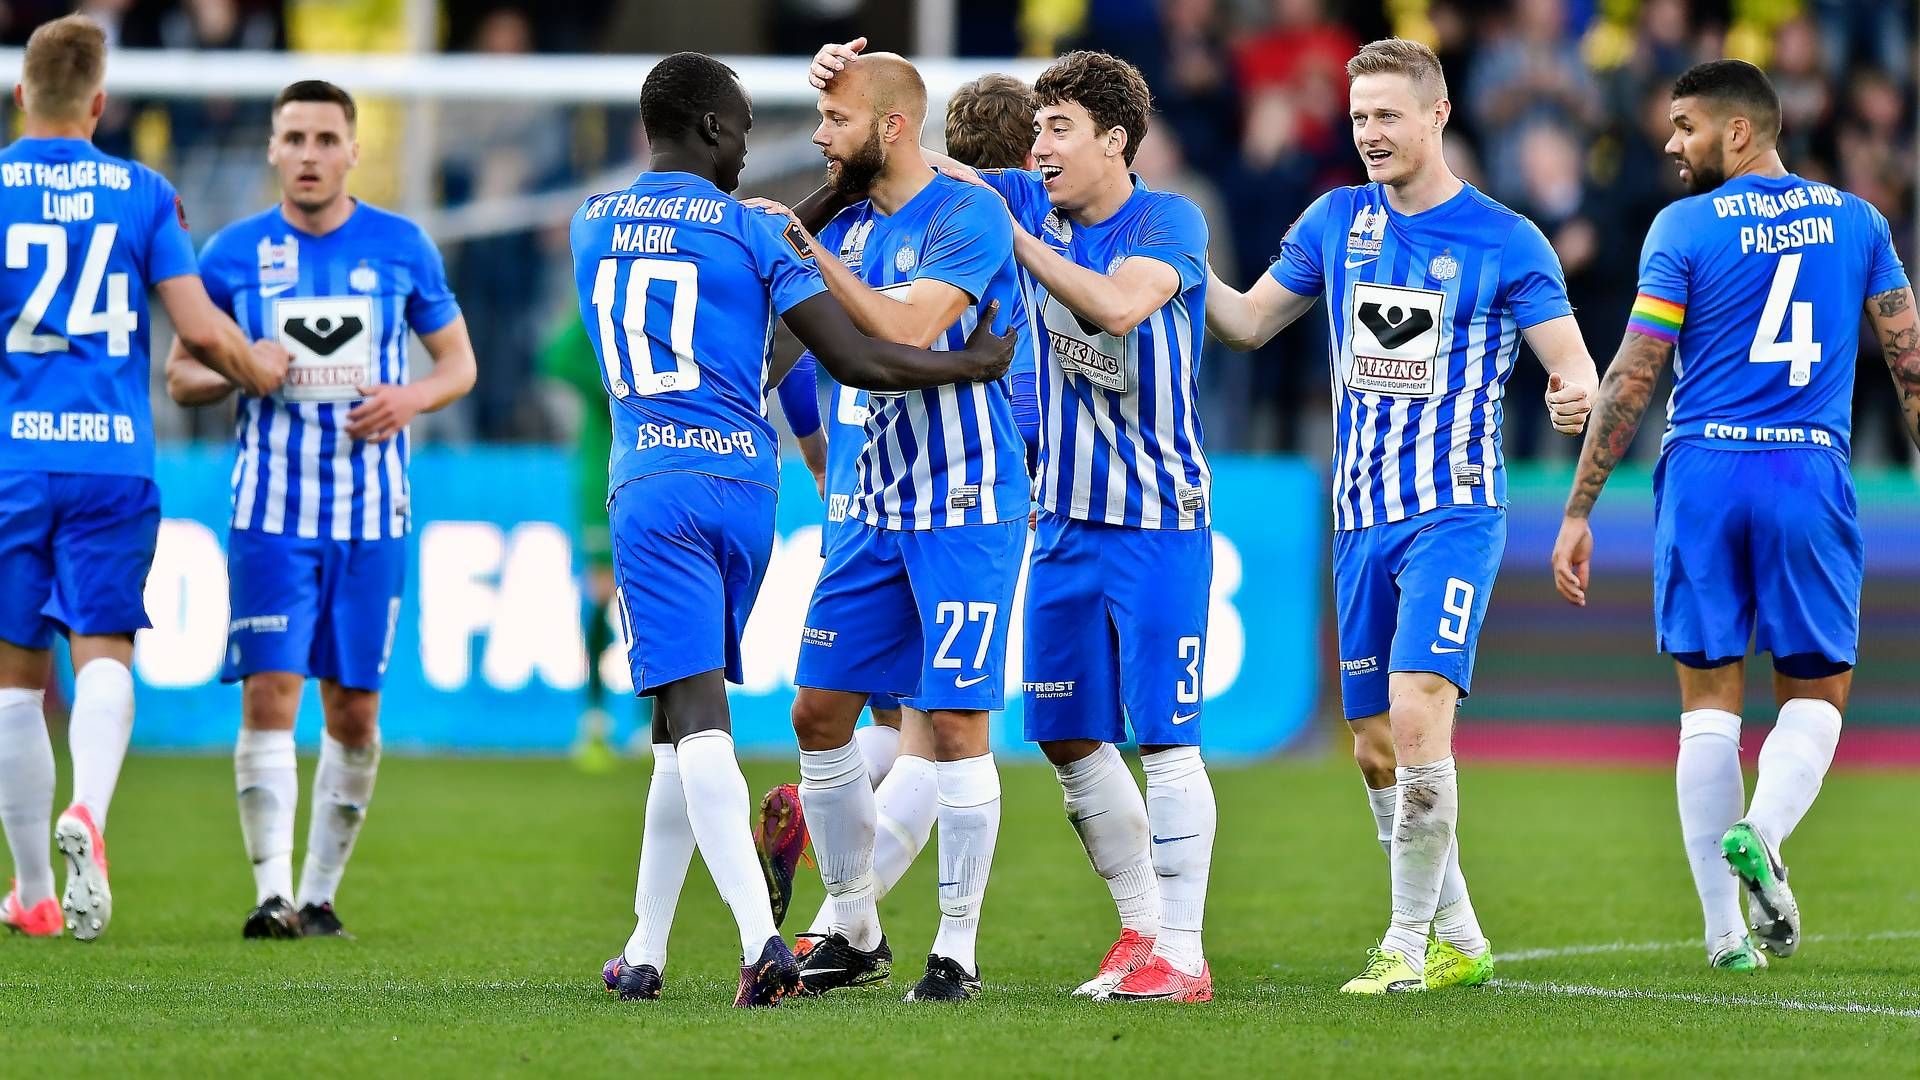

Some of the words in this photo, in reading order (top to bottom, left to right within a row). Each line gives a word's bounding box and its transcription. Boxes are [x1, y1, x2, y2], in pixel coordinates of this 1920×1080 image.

[1, 162, 33, 187] DET
[35, 160, 97, 191] FAGLIGE
[98, 162, 131, 191] HUS
[42, 190, 95, 223] LUND
[611, 194, 688, 220] FAGLIGE
[684, 198, 727, 225] HUS
[1713, 193, 1747, 218] DET
[1746, 187, 1809, 218] FAGLIGE
[1806, 185, 1843, 207] HUS
[611, 223, 678, 254] MABIL
[1740, 216, 1834, 255] PÁLSSON
[5, 222, 138, 357] 24
[591, 256, 701, 401] 10
[1749, 252, 1823, 388] 4
[1355, 355, 1427, 381] VIKING
[1387, 380, 1427, 390] EQUIPMENT
[11, 411, 110, 443] ESBJERG
[1438, 577, 1475, 645] 9
[932, 601, 998, 670] 27
[1176, 636, 1200, 704] 3
[1036, 691, 1073, 699] SOLUTIONS
[1426, 957, 1459, 978] SPEED
